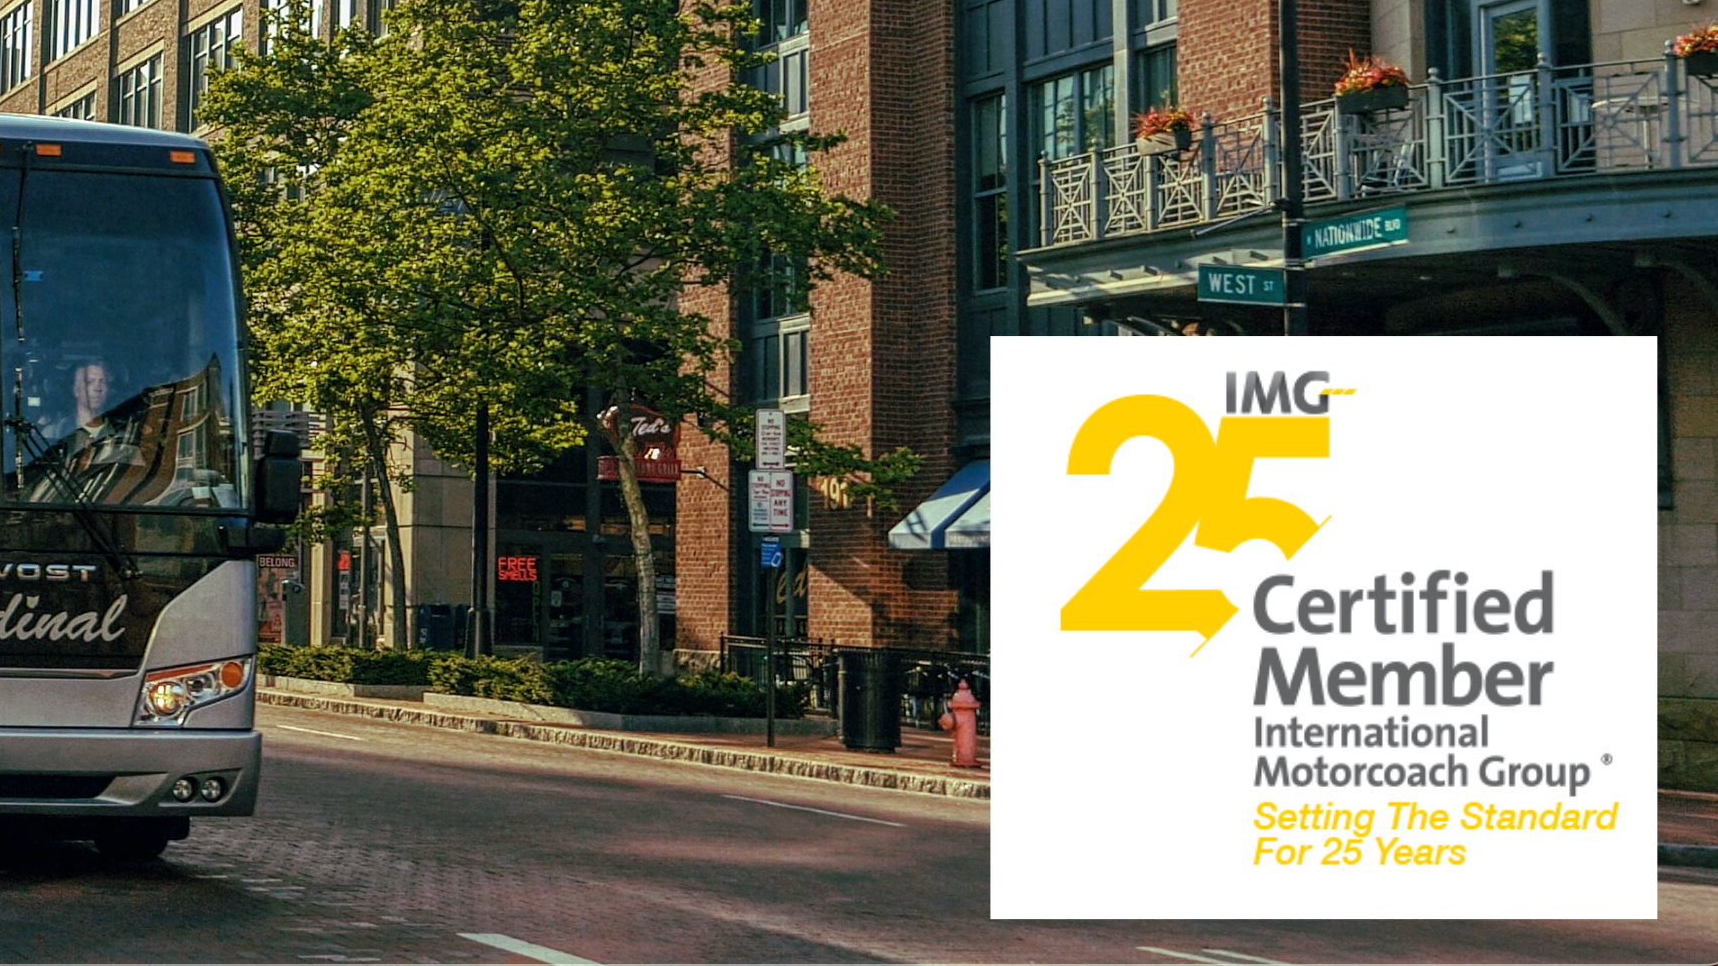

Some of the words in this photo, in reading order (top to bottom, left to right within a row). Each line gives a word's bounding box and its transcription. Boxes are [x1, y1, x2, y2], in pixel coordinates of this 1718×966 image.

[1314, 217, 1382, 249] NATIONWIDE
[1384, 218, 1401, 232] BLVD
[1208, 272, 1256, 295] WEST
[1263, 281, 1274, 292] ST
[631, 417, 671, 436] Ted's
[774, 499, 787, 507] ANY
[773, 508, 788, 516] TIME
[498, 556, 537, 571] FREE
